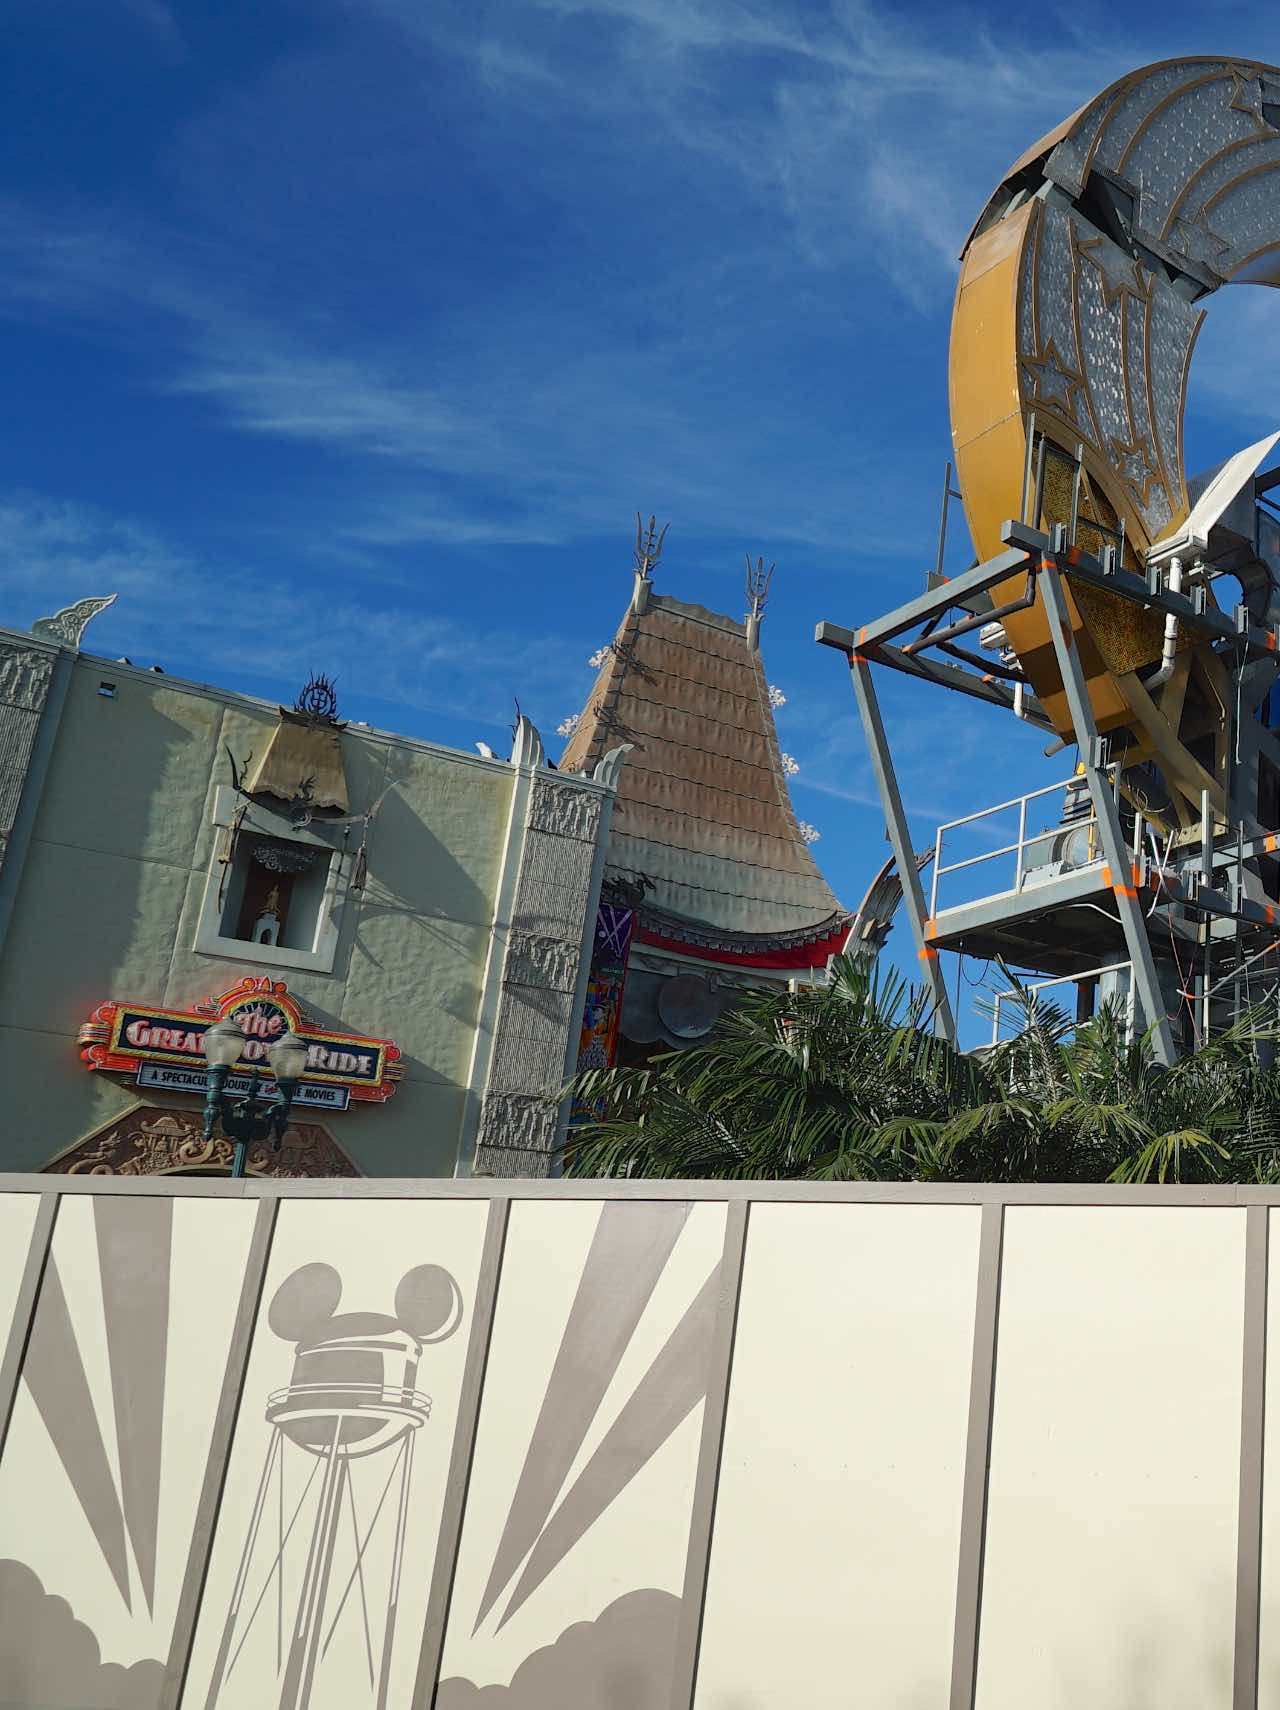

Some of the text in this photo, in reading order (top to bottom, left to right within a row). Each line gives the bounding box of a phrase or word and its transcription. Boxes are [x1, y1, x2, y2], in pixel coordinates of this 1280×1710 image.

[234, 1007, 284, 1038] The
[305, 1044, 374, 1075] RIDE
[304, 1088, 336, 1101] MOVIES
